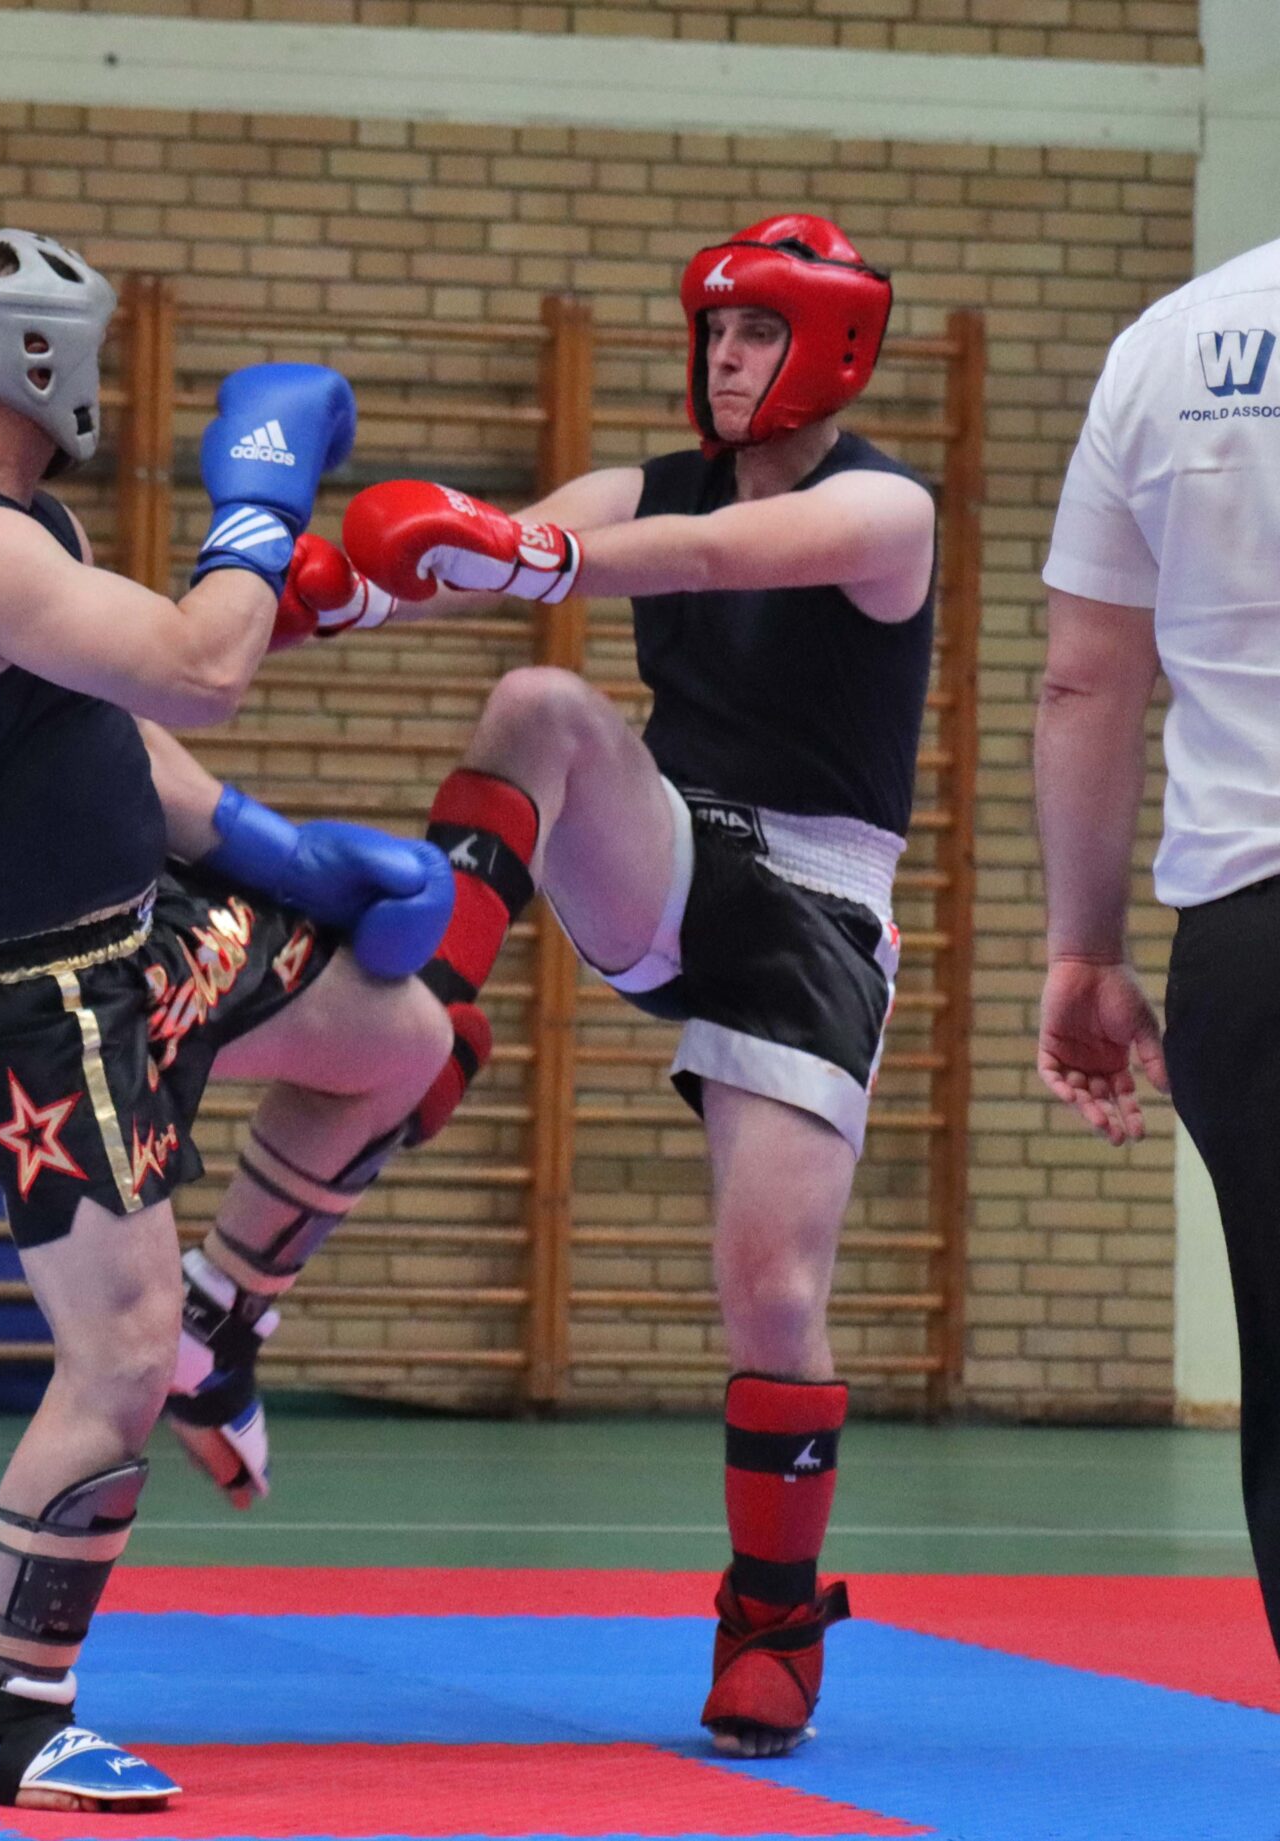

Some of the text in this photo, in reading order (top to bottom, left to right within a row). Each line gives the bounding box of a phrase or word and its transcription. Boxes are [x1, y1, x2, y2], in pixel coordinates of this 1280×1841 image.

[1197, 329, 1276, 397] W
[1179, 407, 1229, 421] WORLD
[230, 445, 296, 467] adidas
